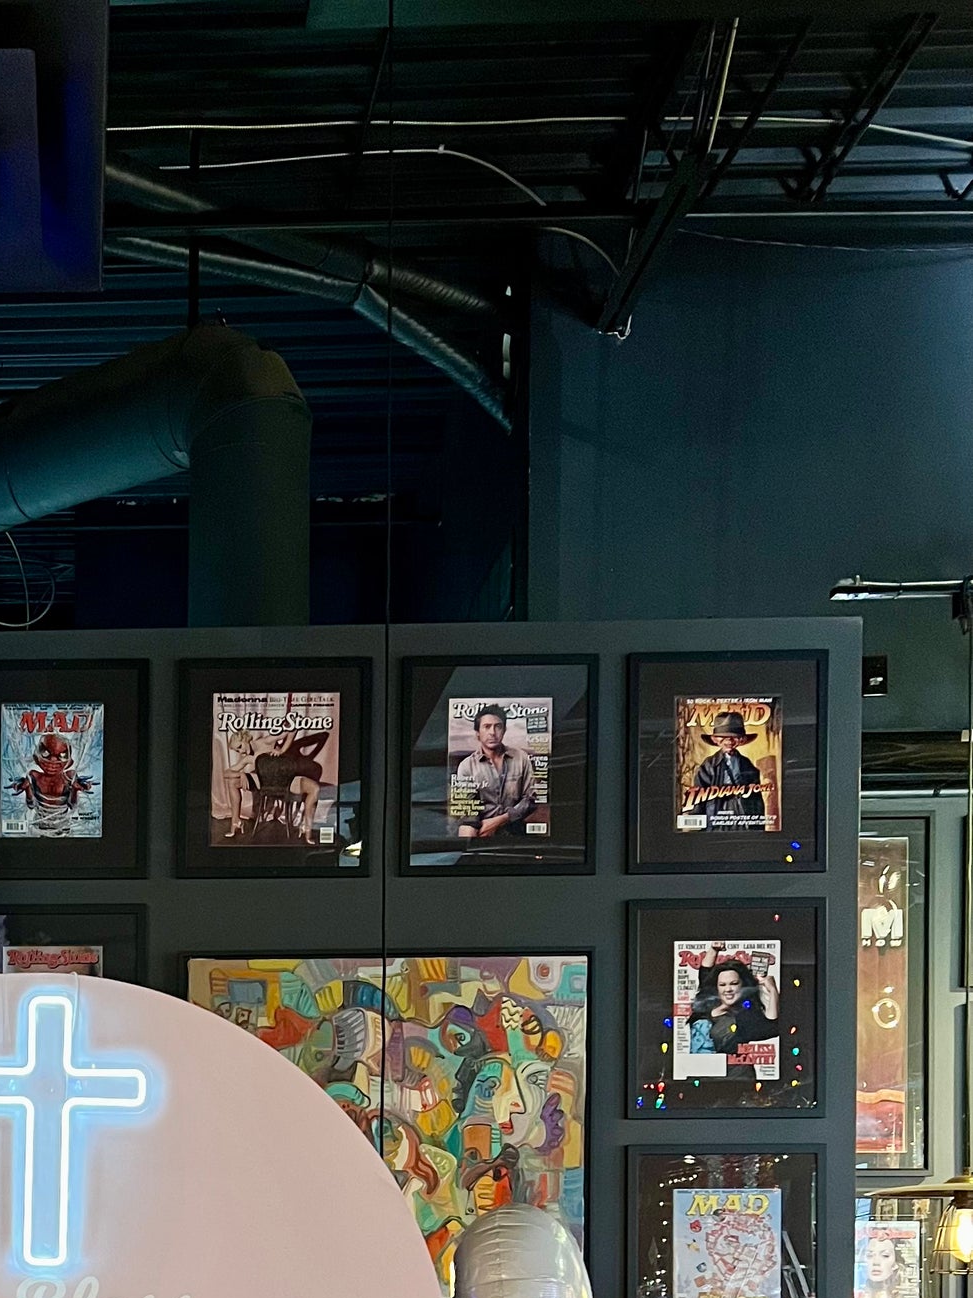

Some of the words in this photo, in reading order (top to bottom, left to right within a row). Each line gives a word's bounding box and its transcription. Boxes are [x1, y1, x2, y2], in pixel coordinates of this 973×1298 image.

[19, 711, 94, 733] MAD
[282, 712, 333, 732] Stone
[682, 784, 745, 812] INDIANA
[686, 1194, 770, 1217] MAD
